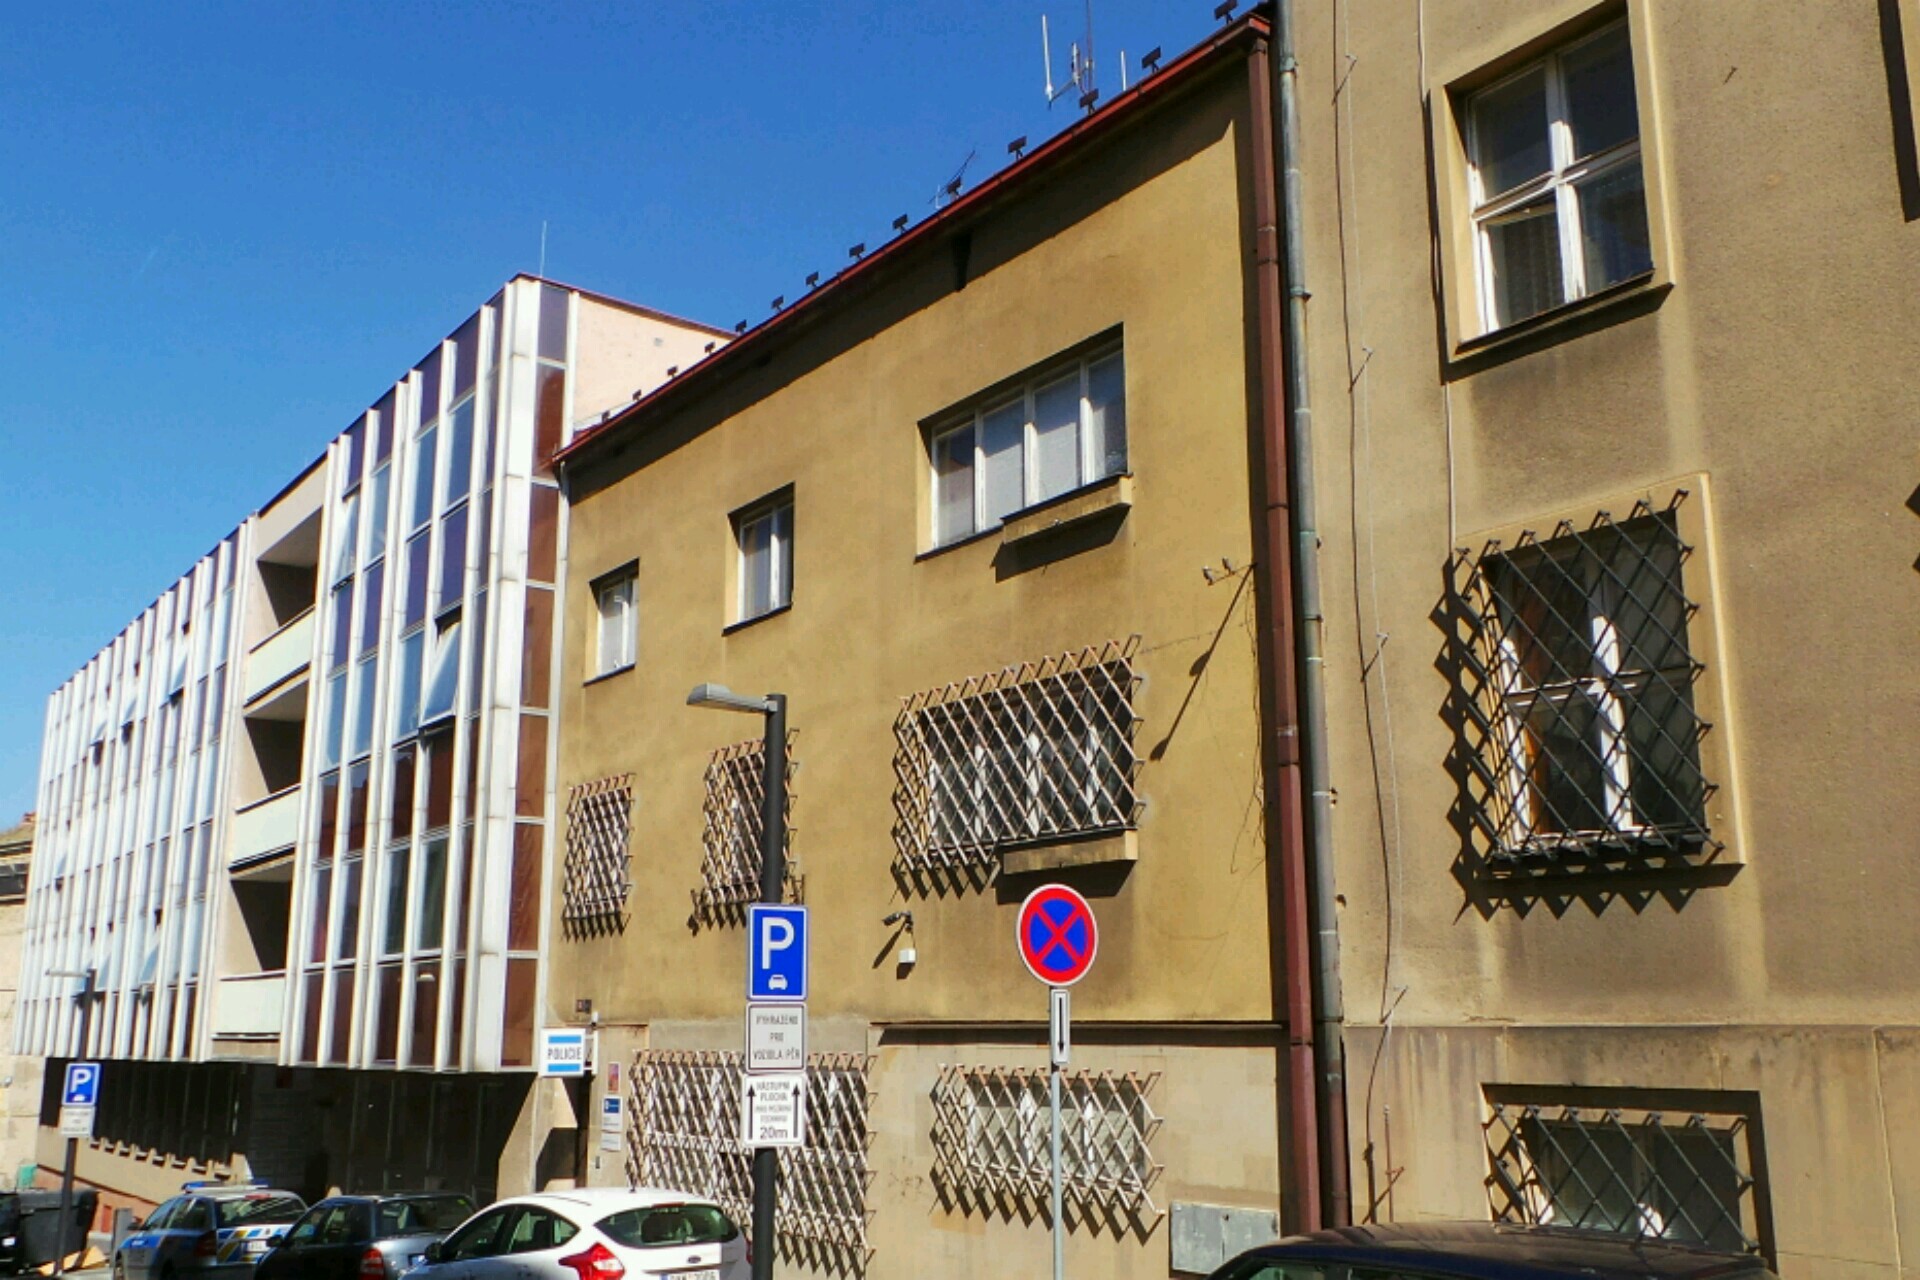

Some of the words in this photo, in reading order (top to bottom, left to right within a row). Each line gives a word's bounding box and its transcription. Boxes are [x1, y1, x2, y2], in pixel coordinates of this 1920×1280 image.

[762, 916, 795, 969] P
[547, 1047, 582, 1060] POLICIE
[70, 1069, 92, 1093] P
[760, 1126, 788, 1139] 20m
